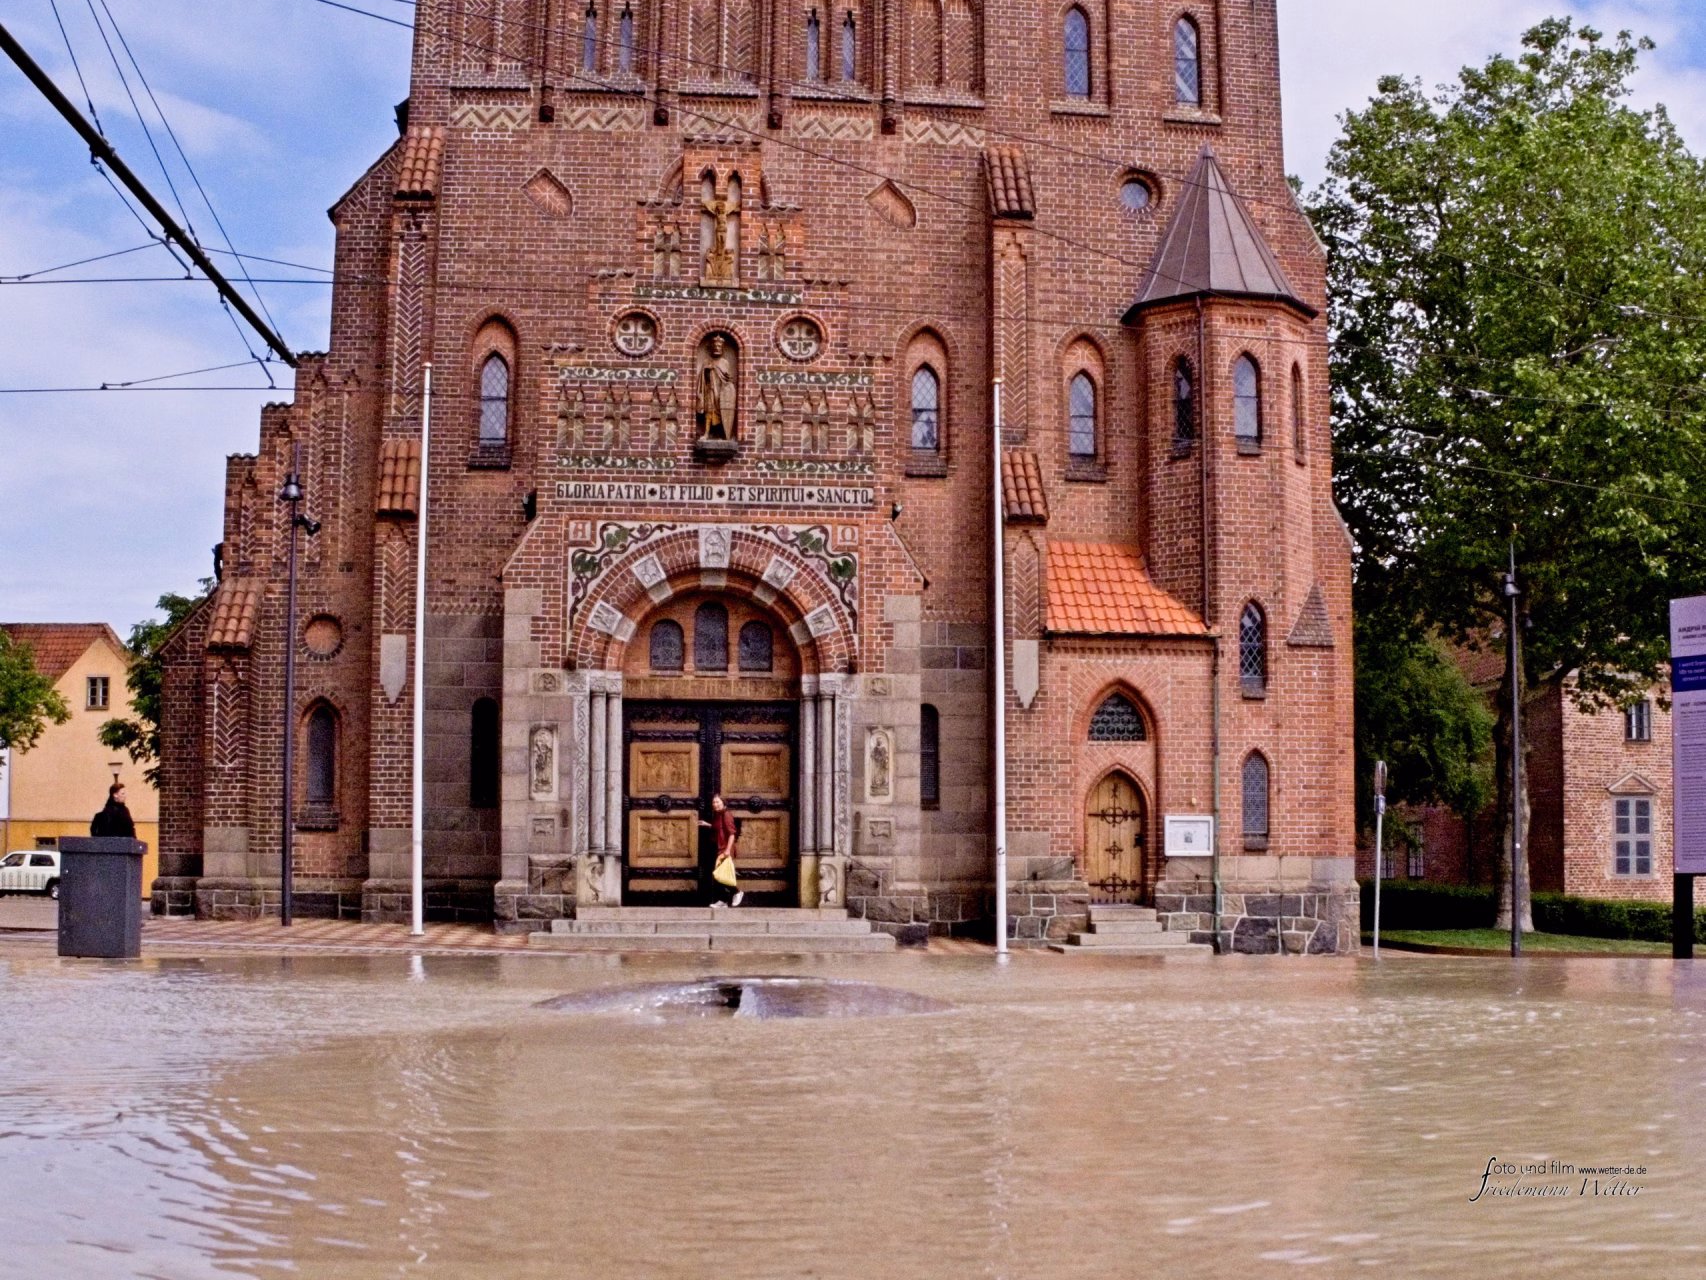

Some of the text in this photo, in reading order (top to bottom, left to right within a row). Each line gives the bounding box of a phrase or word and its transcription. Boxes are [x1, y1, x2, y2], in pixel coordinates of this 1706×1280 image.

[556, 483, 602, 499] GLORIA
[607, 483, 646, 499] PATRI
[659, 485, 676, 500] ET
[679, 485, 713, 501] FILIO
[728, 486, 745, 501] ET
[748, 486, 804, 503] SPIRITUI
